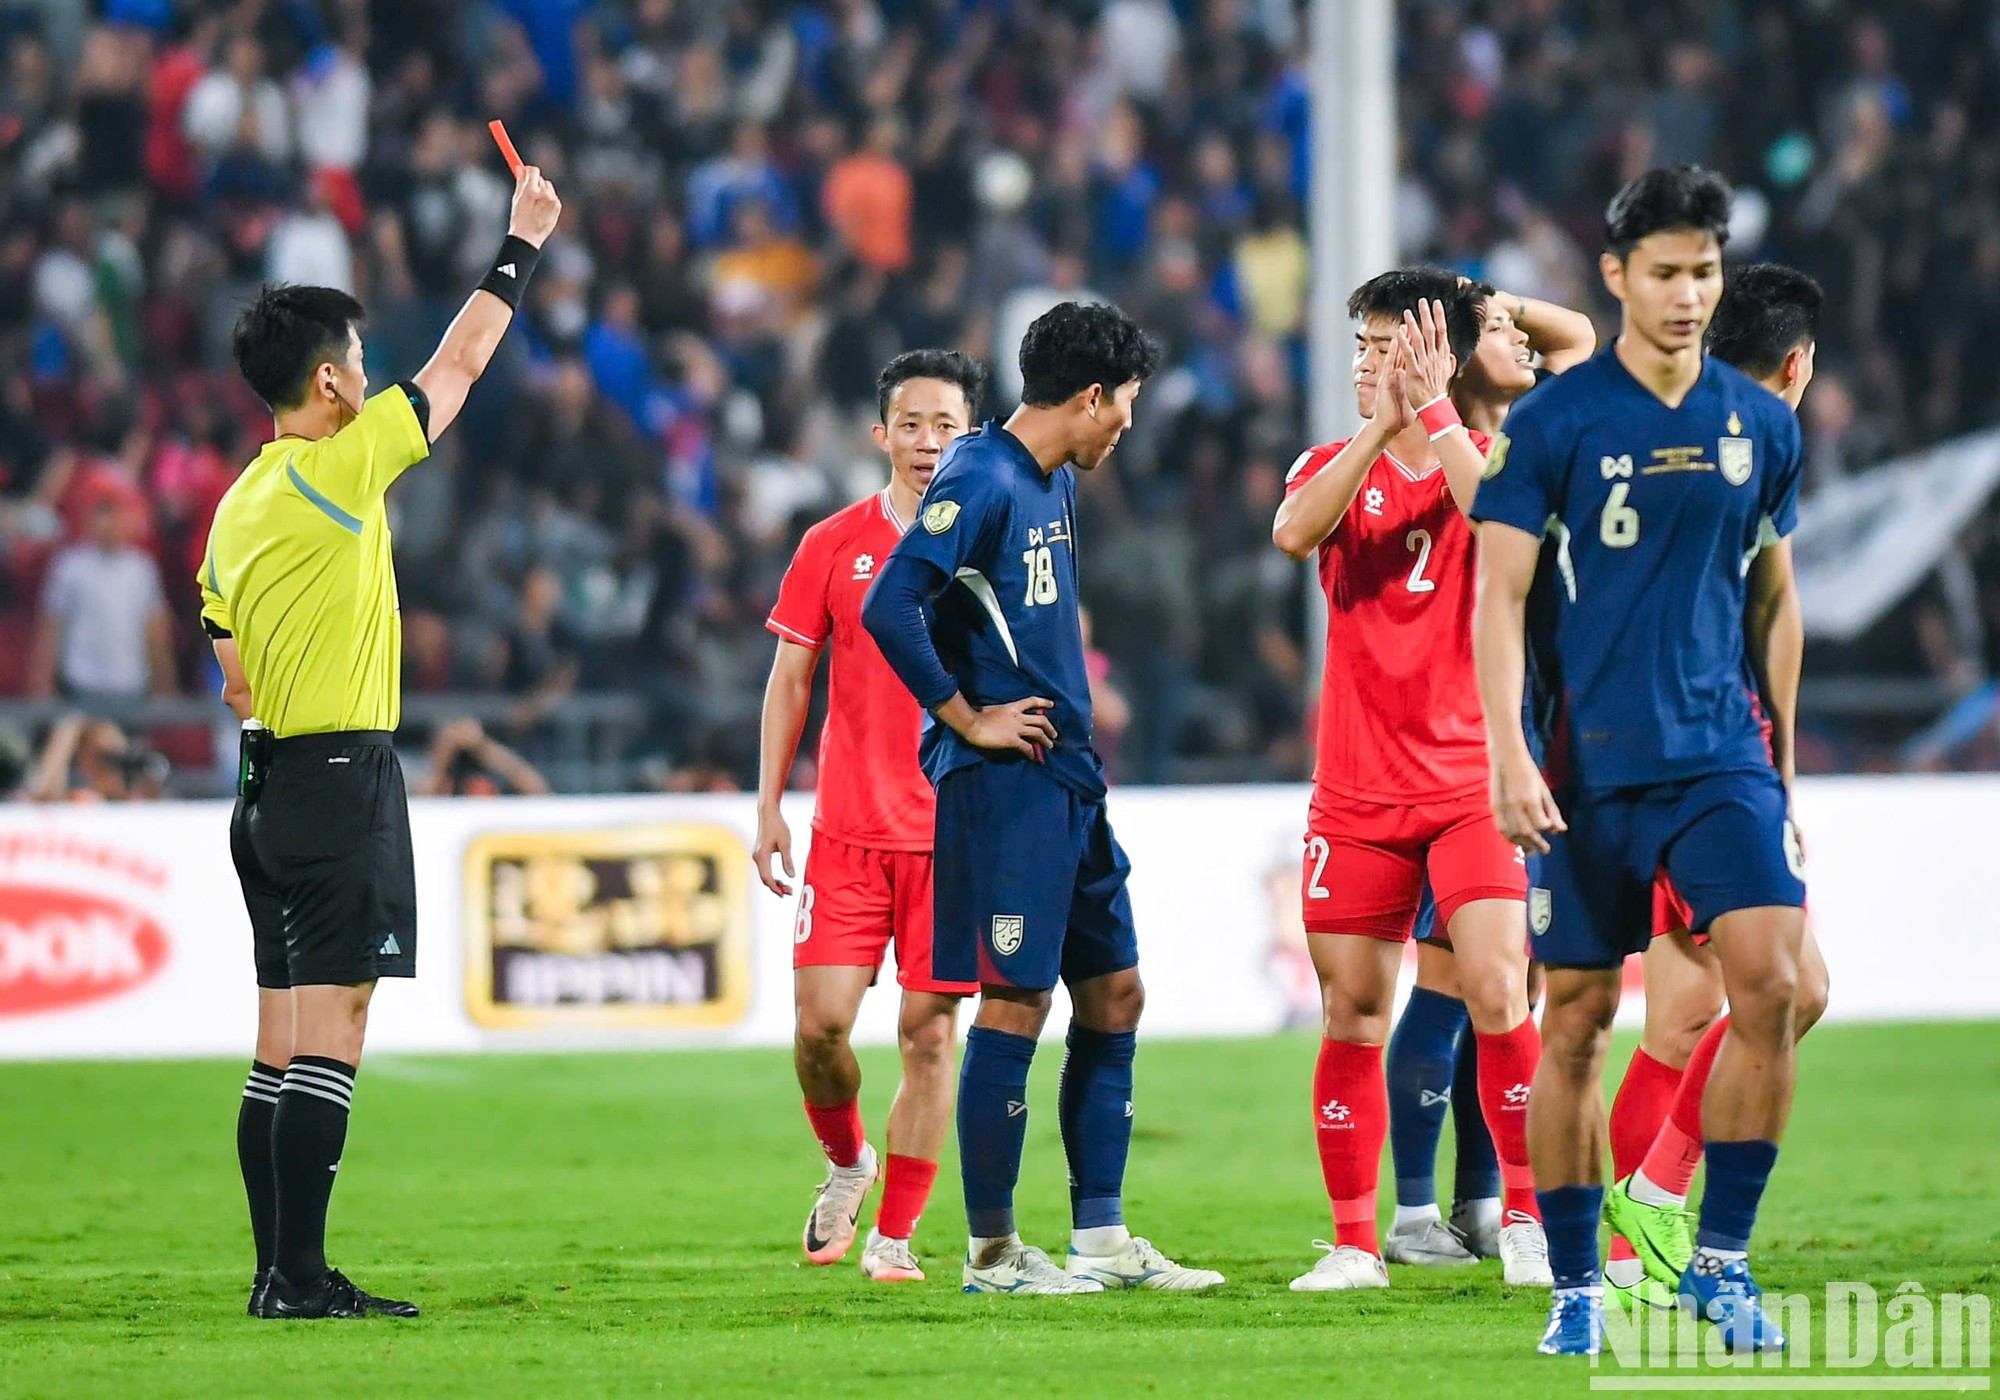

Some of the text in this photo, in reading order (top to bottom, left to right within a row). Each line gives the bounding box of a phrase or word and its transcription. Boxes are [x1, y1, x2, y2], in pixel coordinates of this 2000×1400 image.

[1600, 482, 1640, 548] 6
[1022, 546, 1058, 607] 18
[1406, 528, 1435, 593] 2
[1307, 836, 1330, 899] 2
